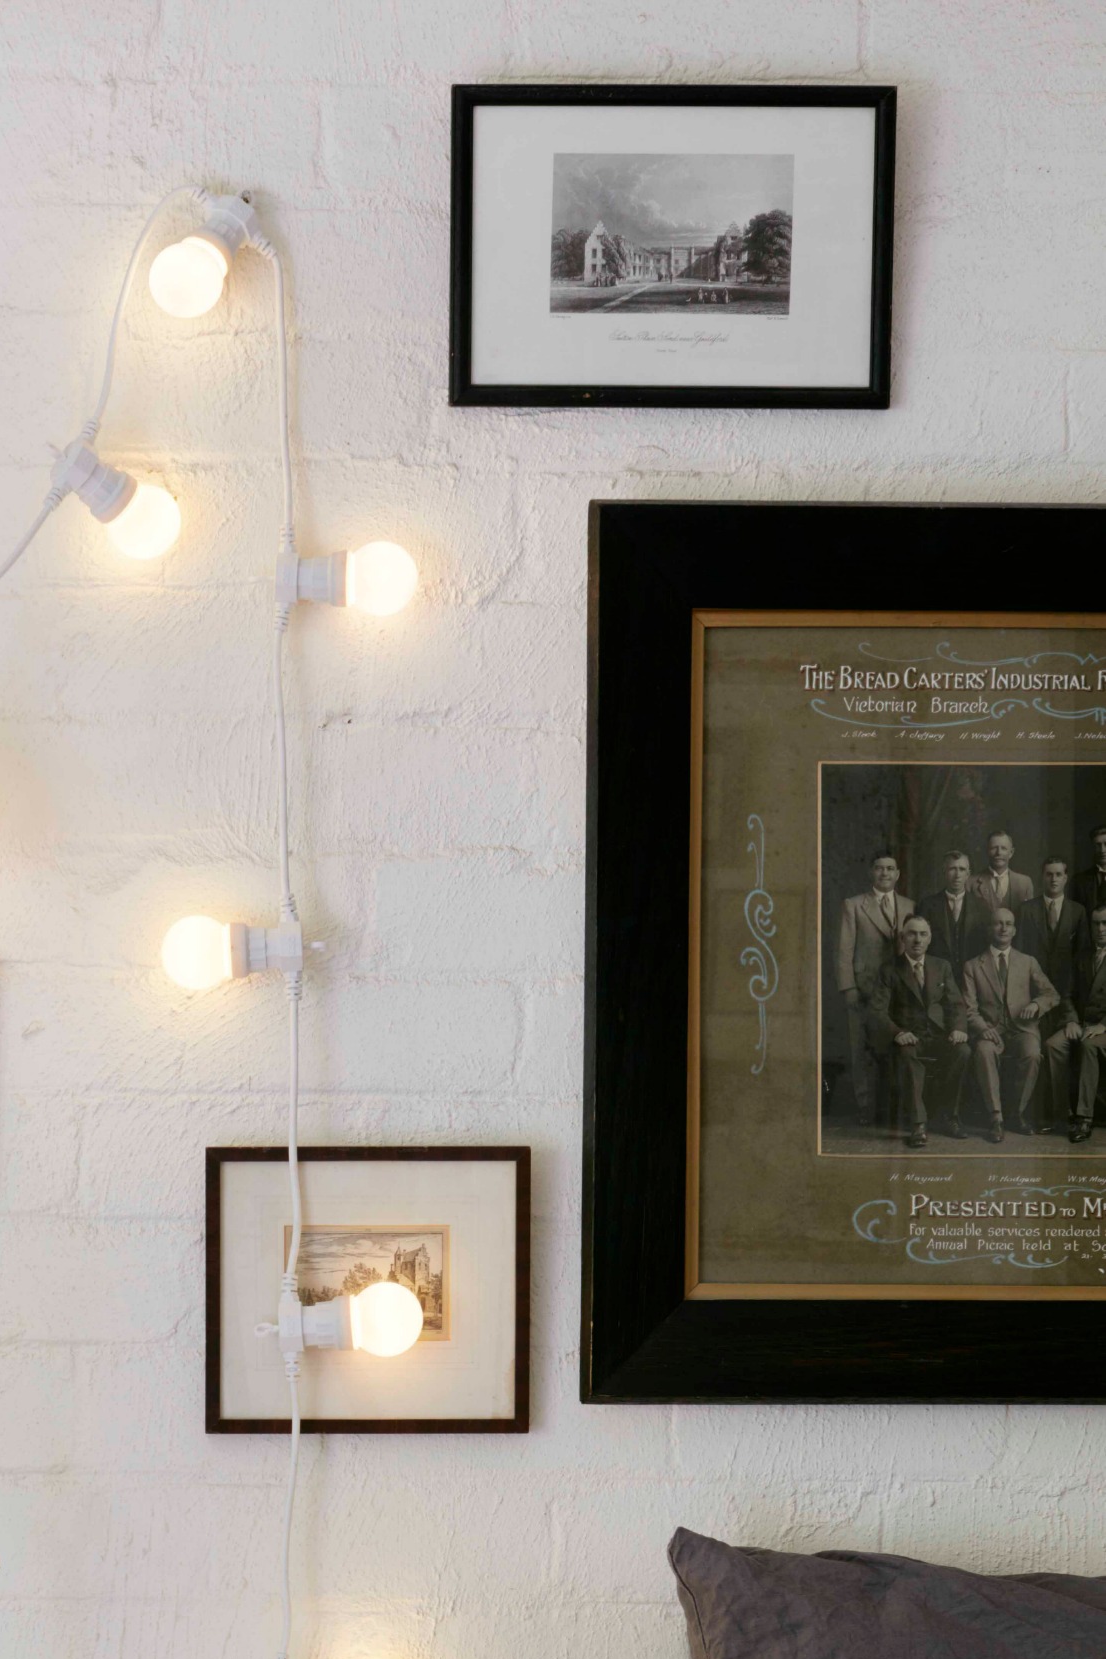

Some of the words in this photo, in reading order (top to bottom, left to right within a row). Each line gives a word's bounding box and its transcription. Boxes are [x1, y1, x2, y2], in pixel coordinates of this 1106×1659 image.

[800, 664, 834, 690] THE
[839, 665, 900, 690] BREAD
[903, 666, 989, 690] CARTERS'
[990, 667, 1091, 691] INDUSTRIAL
[843, 695, 917, 714] Victorian
[931, 696, 991, 714] Branch
[910, 1194, 1056, 1217] PRESENTED
[909, 1223, 926, 1236] For
[931, 1222, 982, 1236] valuable
[987, 1226, 1041, 1237] services
[1045, 1225, 1101, 1237] rendered
[926, 1238, 968, 1250] Annual
[977, 1239, 1015, 1251] Picnic
[1022, 1239, 1052, 1251] held
[1063, 1241, 1080, 1252] at
